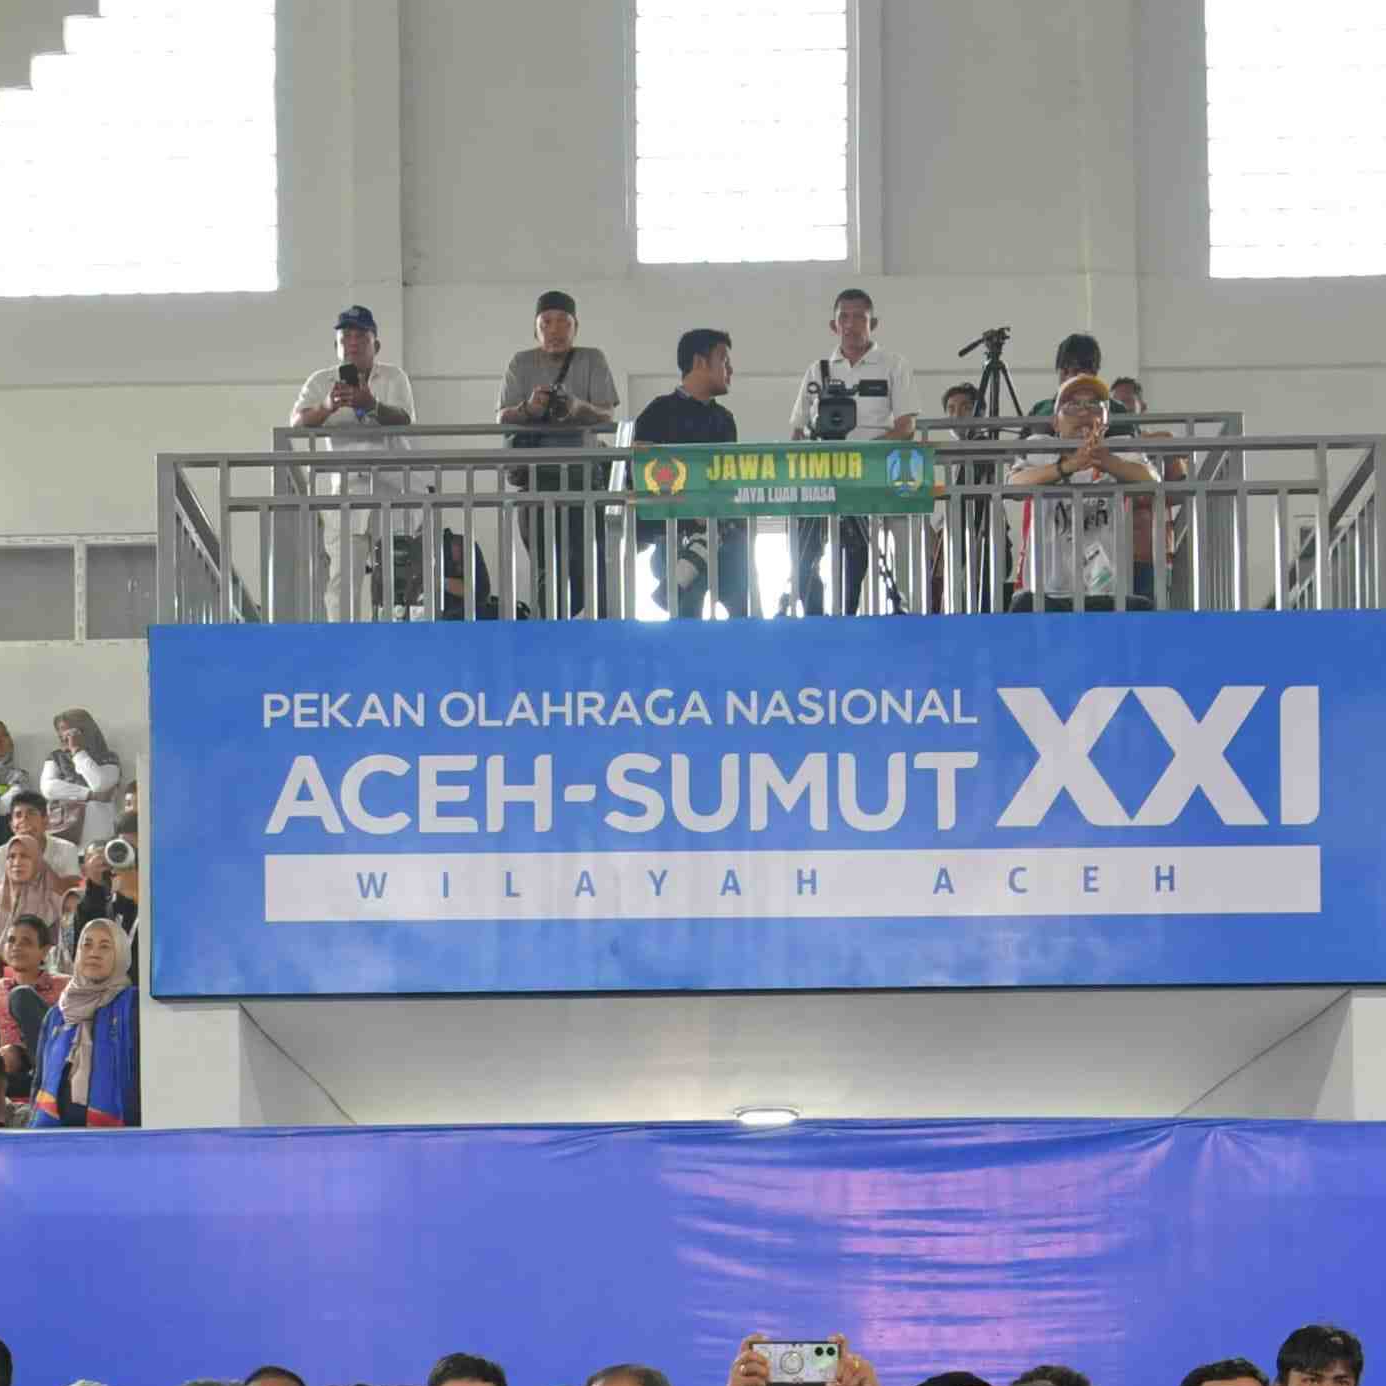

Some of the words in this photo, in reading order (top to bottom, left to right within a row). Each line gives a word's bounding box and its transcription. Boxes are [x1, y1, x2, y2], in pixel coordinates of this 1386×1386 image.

[706, 453, 777, 481] JAWA
[787, 452, 863, 480] TIMUR
[733, 487, 766, 504] JAYA
[263, 692, 425, 728] PEKAN
[439, 689, 712, 728] OLAHRAGA
[726, 687, 978, 725] NASIONAL
[265, 751, 979, 835] ACEH-SUMUT
[995, 685, 1321, 828] XXI
[356, 868, 817, 899] WILAYAH
[932, 864, 1176, 895] ACEH
